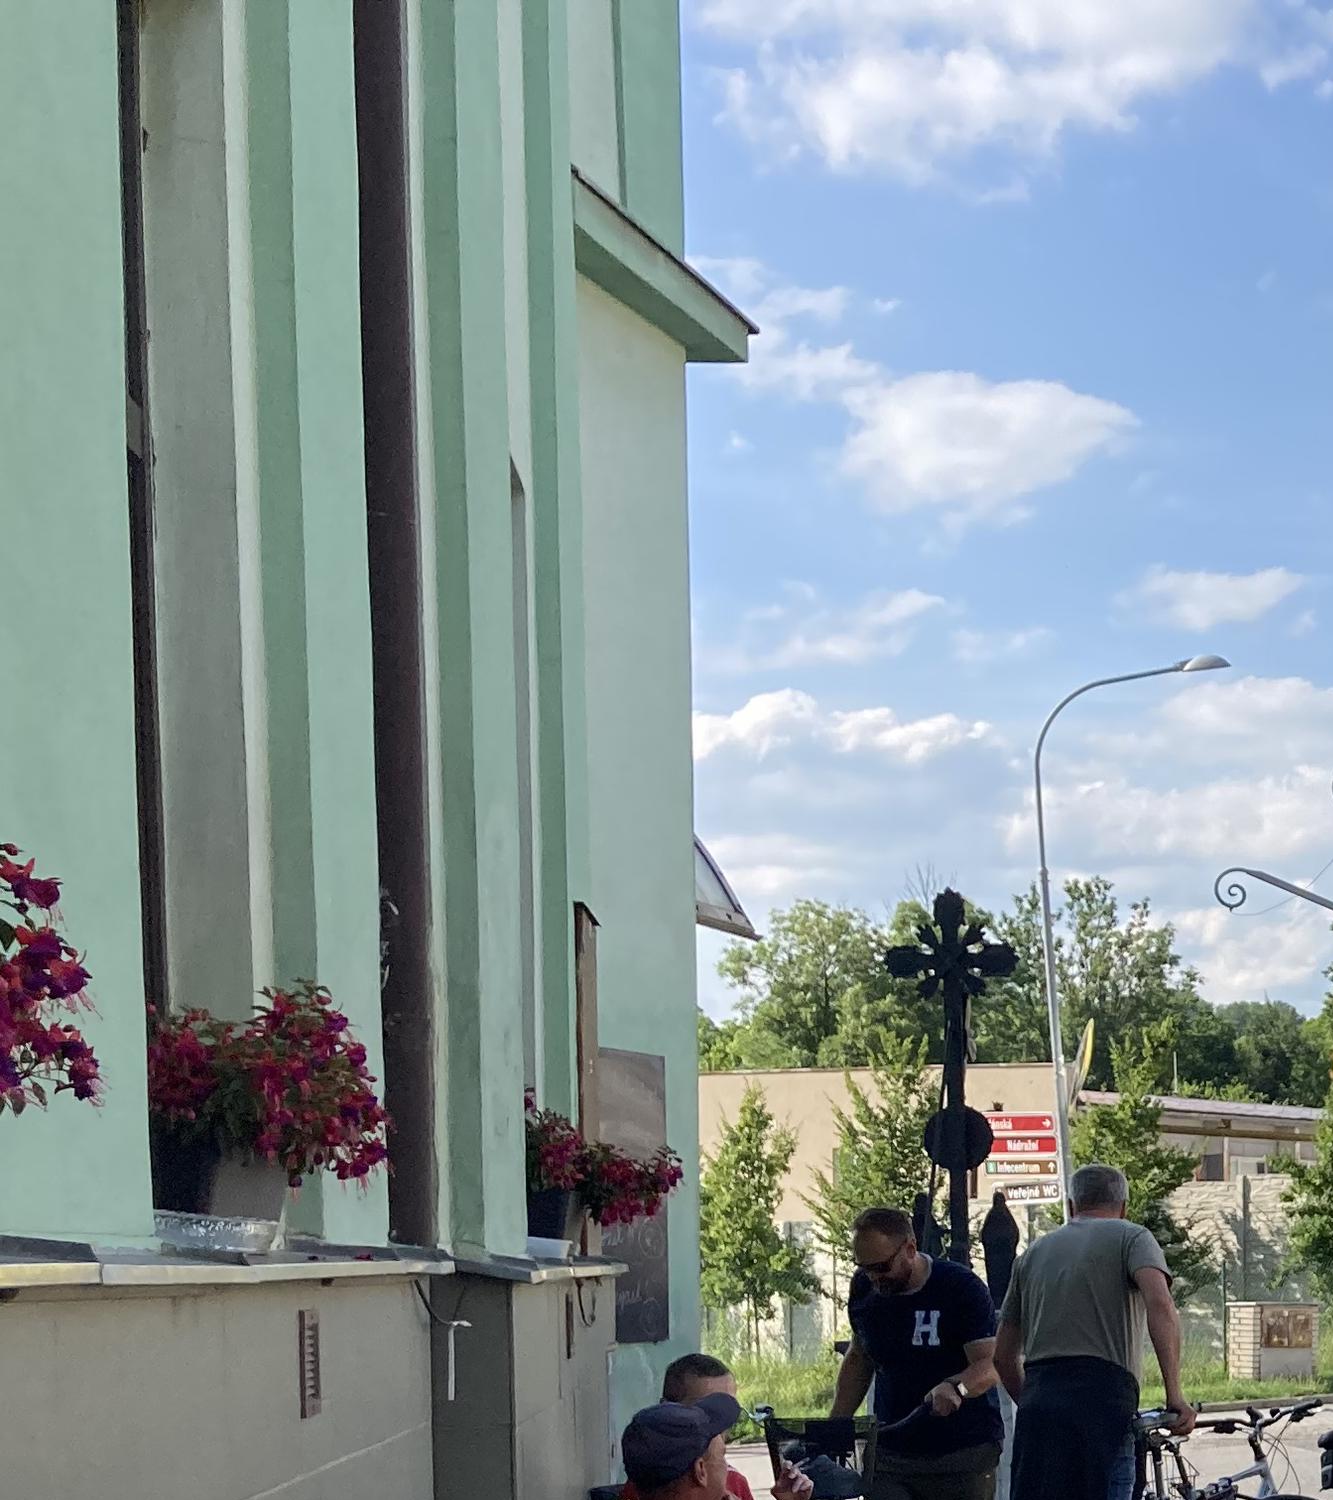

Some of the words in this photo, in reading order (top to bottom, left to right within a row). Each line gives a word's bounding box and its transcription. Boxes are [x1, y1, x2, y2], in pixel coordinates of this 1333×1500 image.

[1006, 1140, 1040, 1151] Nádražní
[997, 1161, 1040, 1173] Infocentrum
[1043, 1185, 1058, 1197] WC
[912, 1310, 940, 1346] H
